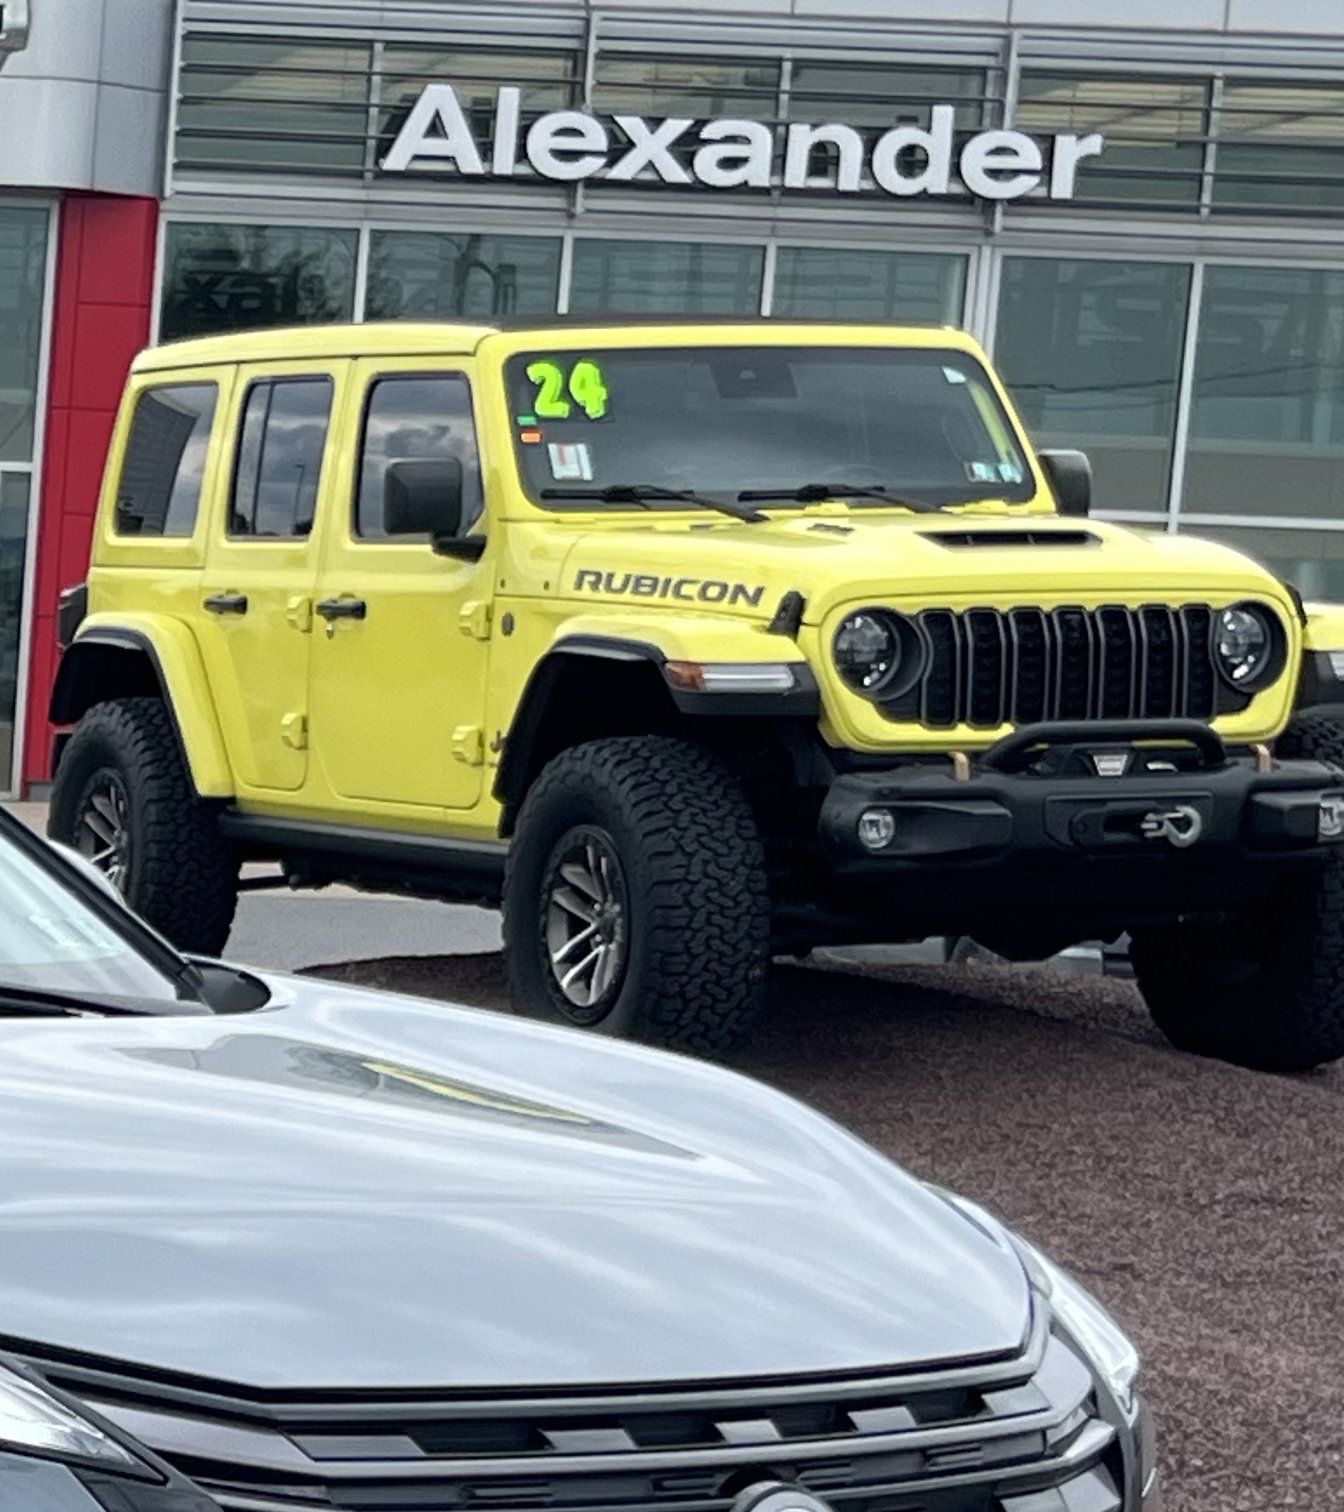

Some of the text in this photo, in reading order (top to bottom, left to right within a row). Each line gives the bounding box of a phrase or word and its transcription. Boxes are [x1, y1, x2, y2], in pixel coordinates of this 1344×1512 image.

[381, 83, 1103, 199] Alexander
[525, 361, 608, 419] 24
[574, 569, 766, 607] RUBICON
